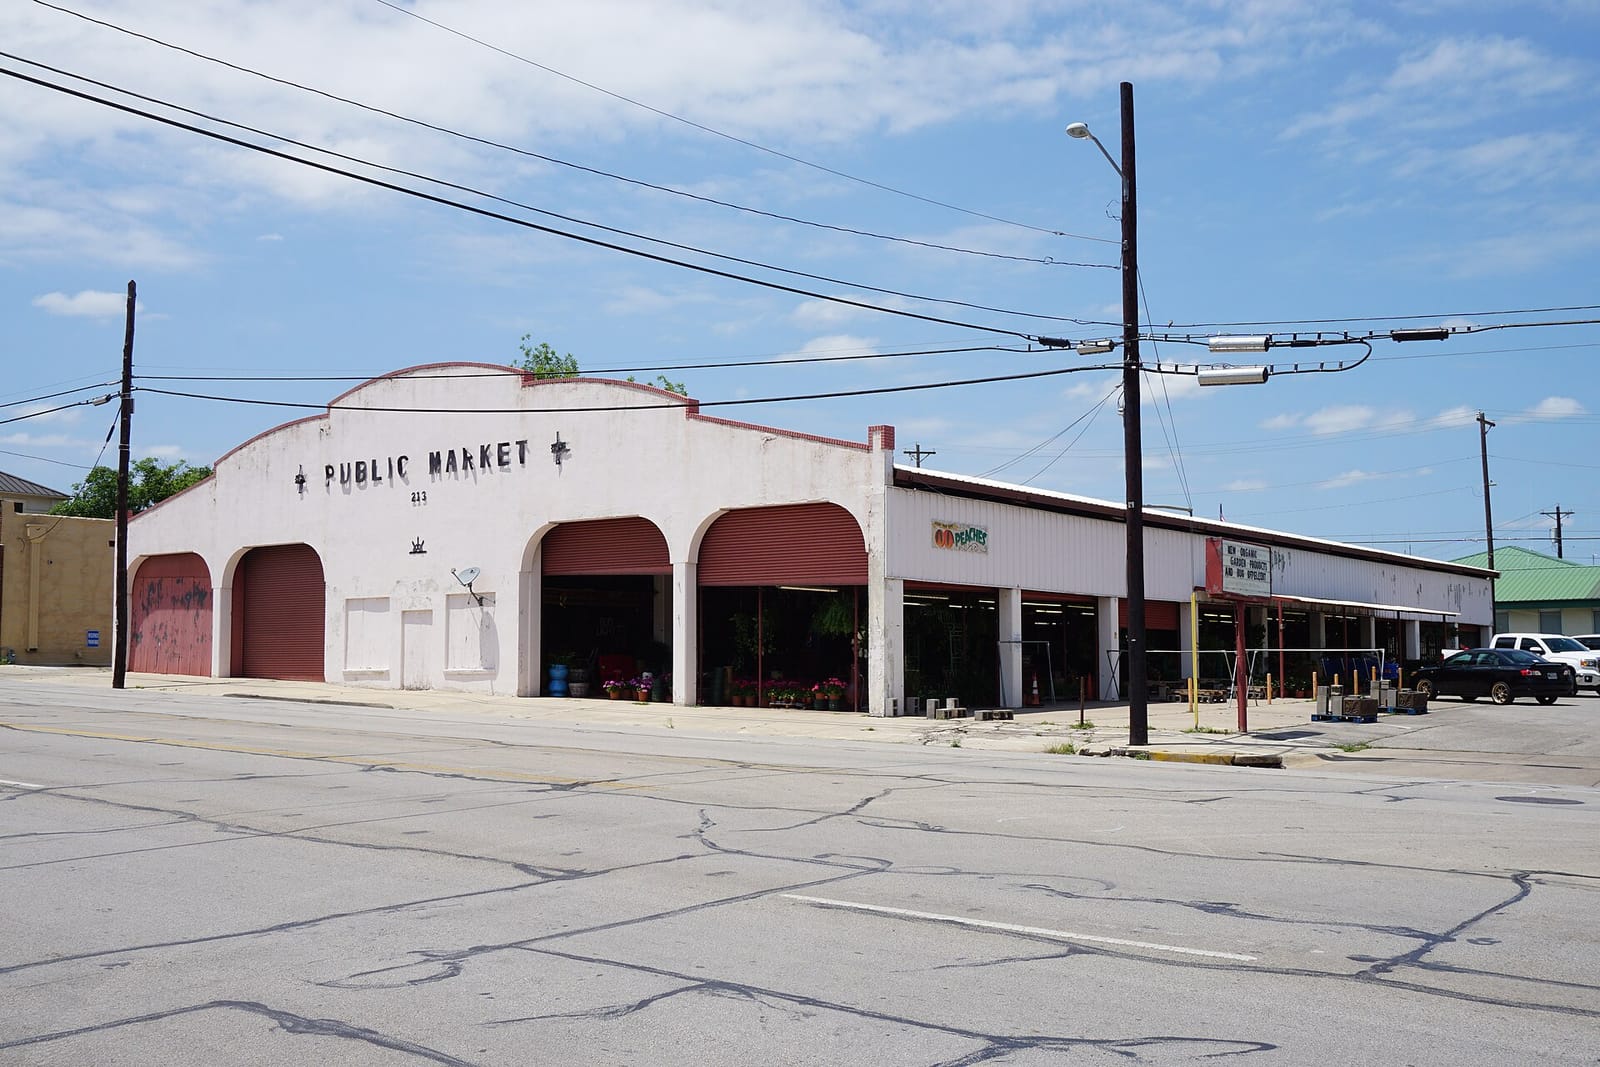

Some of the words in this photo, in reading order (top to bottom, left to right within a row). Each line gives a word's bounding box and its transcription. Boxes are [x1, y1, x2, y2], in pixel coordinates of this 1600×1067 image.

[325, 455, 409, 487] PUBLIC
[429, 440, 527, 474] MARKET
[411, 491, 427, 502] 213
[954, 527, 987, 547] PEACHES
[1240, 547, 1257, 558] ORGANIC
[1230, 556, 1246, 567] GARDEN
[1249, 560, 1267, 571] PRODUCTS
[1225, 567, 1233, 577] AND
